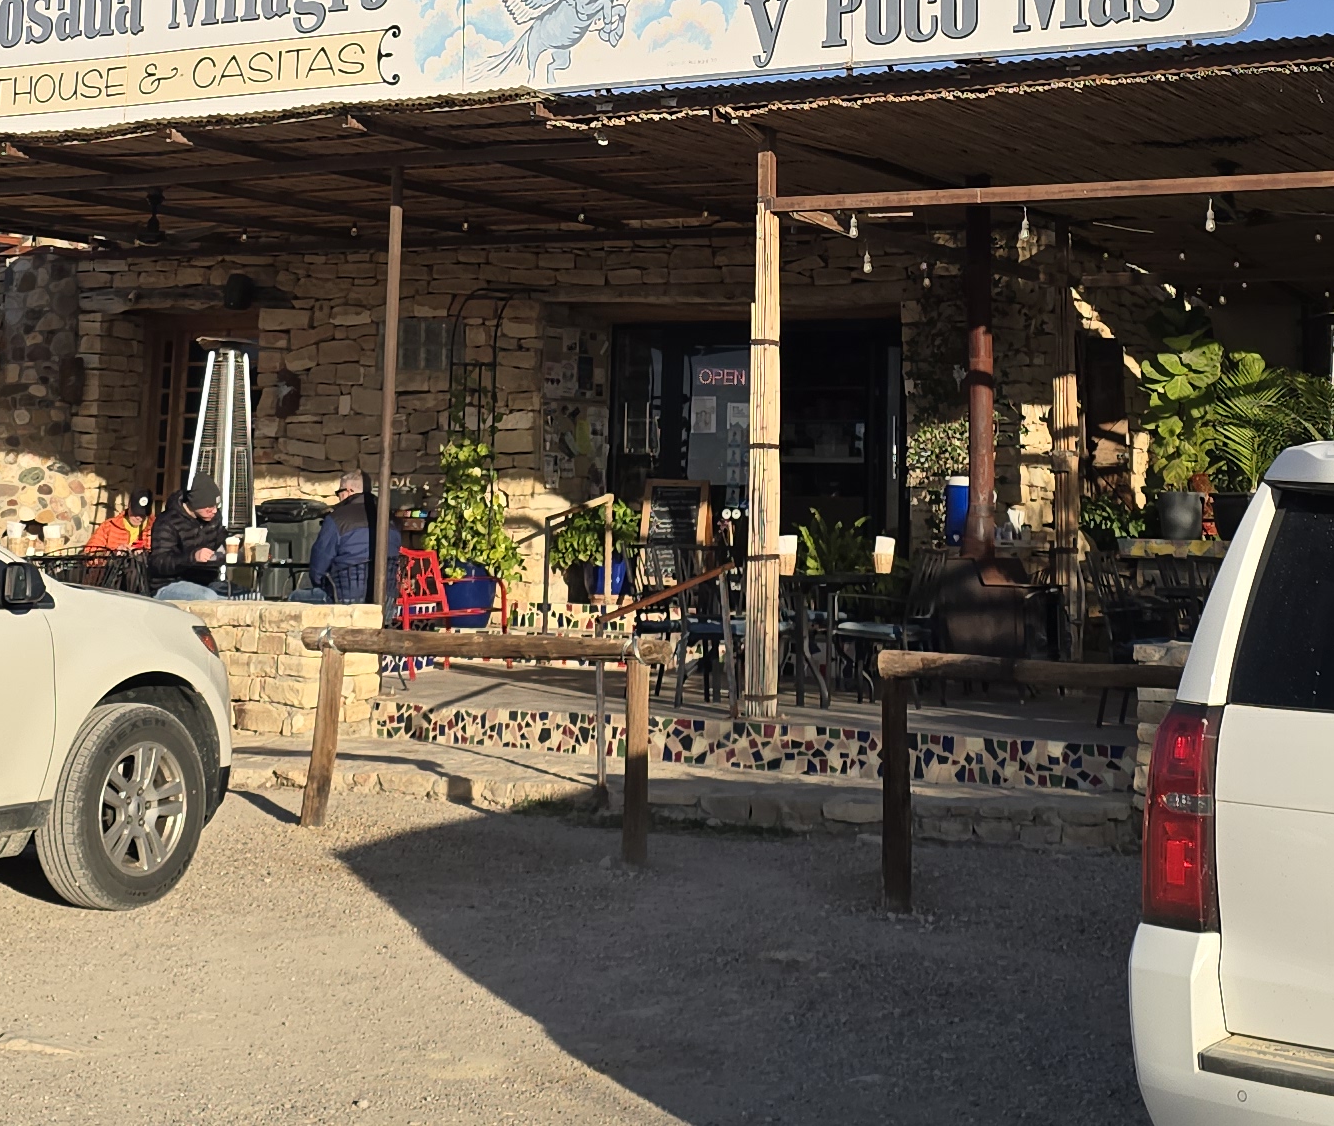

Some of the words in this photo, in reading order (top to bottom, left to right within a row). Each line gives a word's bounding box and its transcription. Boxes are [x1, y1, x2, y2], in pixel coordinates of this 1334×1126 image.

[138, 63, 181, 90] &
[192, 42, 366, 89] CASITAS
[698, 368, 746, 385] OPEN
[103, 716, 167, 757] NEXEN
